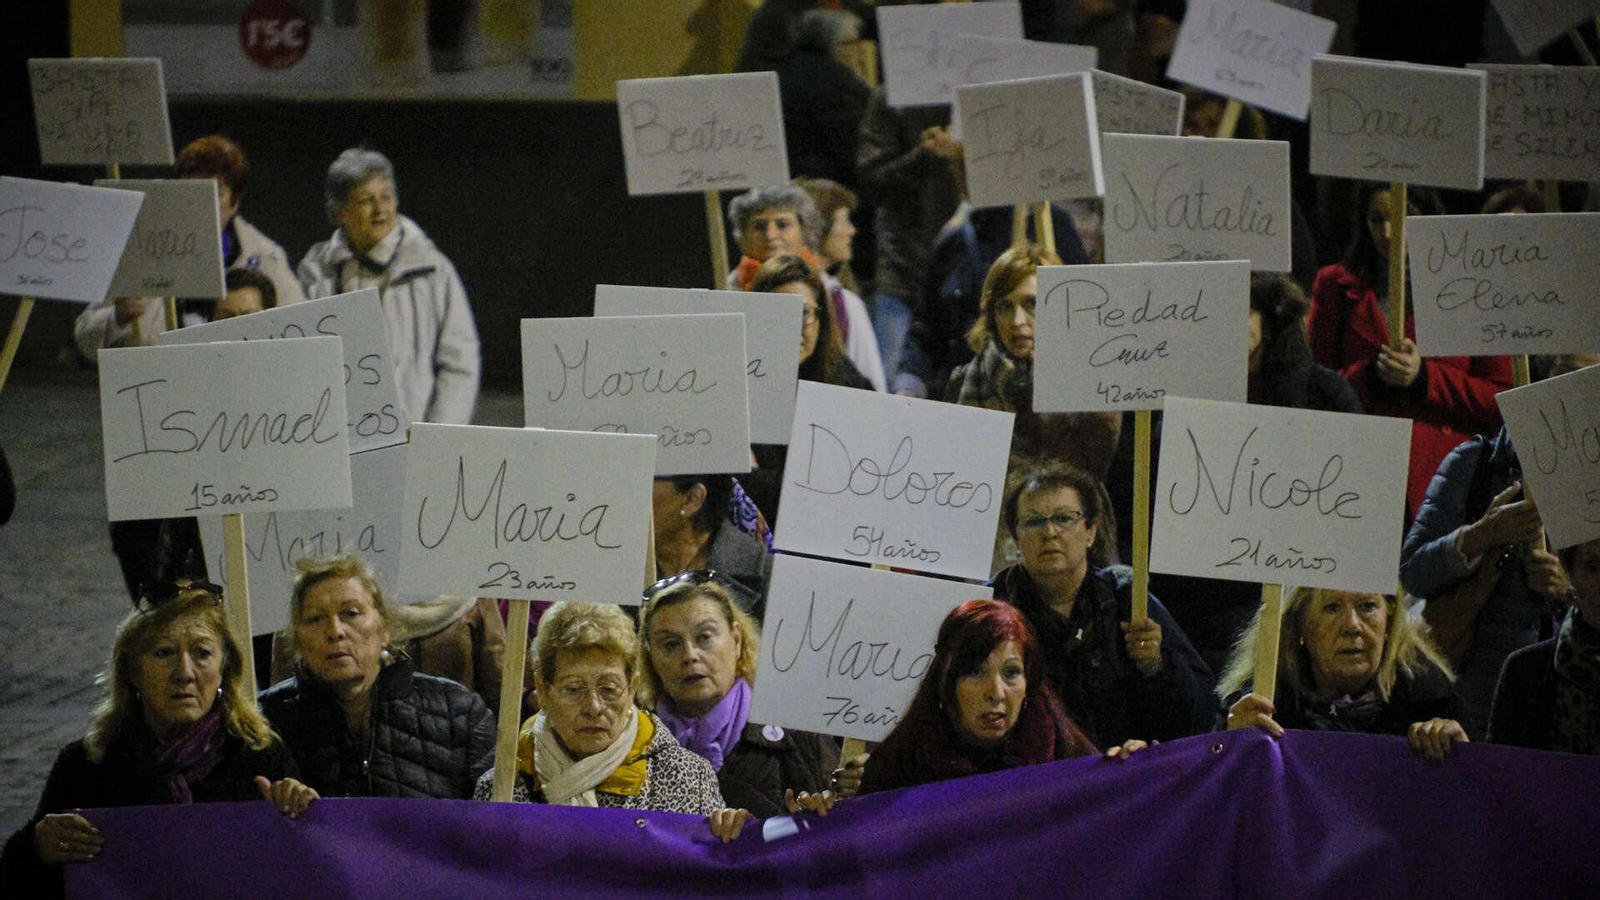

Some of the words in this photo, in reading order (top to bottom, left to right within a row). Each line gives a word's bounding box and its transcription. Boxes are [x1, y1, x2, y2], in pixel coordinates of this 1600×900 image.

[1490, 73, 1559, 98] ASTA
[625, 100, 777, 156] Beatriz
[1319, 87, 1453, 141] Daria
[1113, 163, 1276, 238] Natalia
[0, 204, 89, 263] Jose
[134, 229, 202, 260] aria
[1427, 230, 1549, 273] Maria
[1044, 279, 1209, 329] Piedad
[1436, 277, 1565, 311] Elena
[549, 339, 718, 402] Maria
[1089, 333, 1169, 367] Cruz
[113, 379, 339, 463] Ismael
[656, 425, 713, 448] ños
[794, 423, 993, 513] Dolores
[1169, 426, 1363, 518] Nicole
[418, 456, 622, 550] Maria
[526, 571, 577, 591] años
